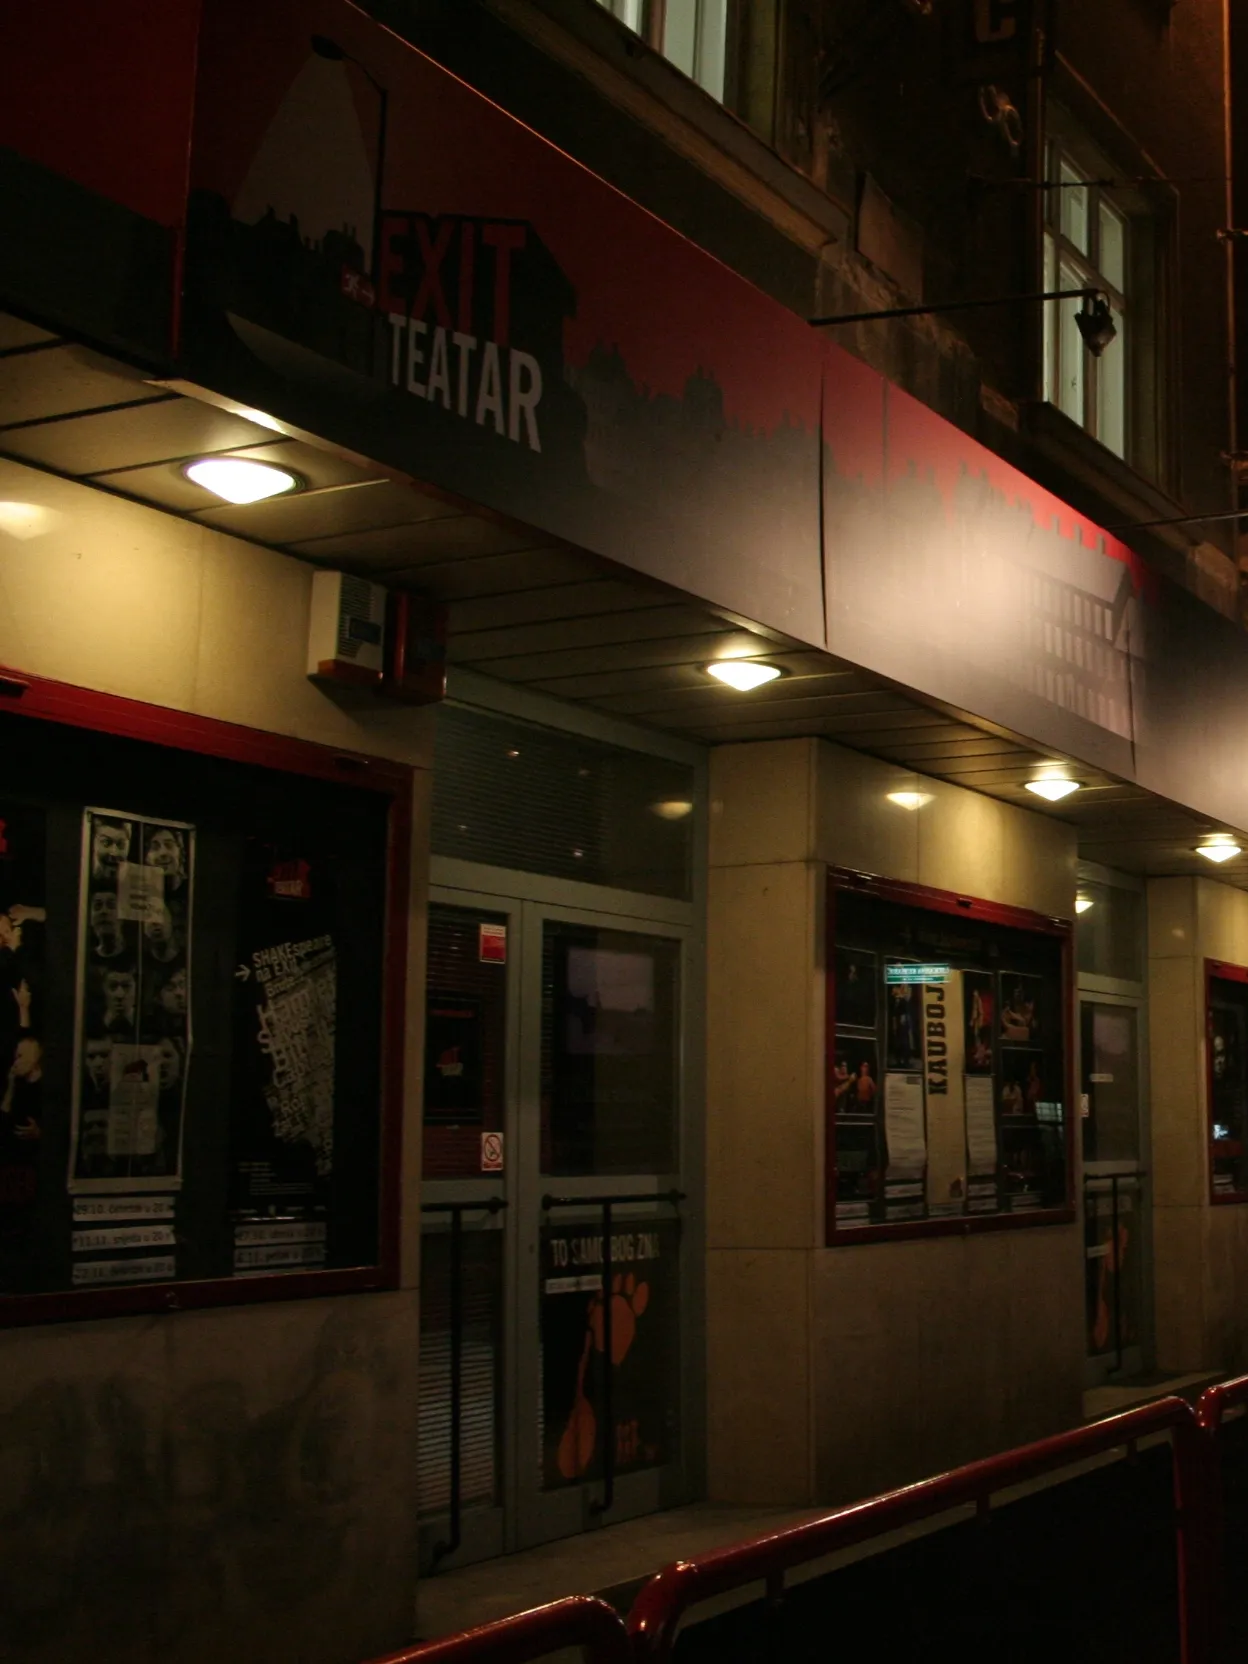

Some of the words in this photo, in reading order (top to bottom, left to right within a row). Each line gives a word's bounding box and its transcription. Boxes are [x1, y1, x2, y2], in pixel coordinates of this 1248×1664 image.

[377, 217, 527, 348] EXIT
[389, 312, 544, 453] TEATAR
[926, 983, 947, 1092] KAUBOJ
[550, 1238, 569, 1268] TO
